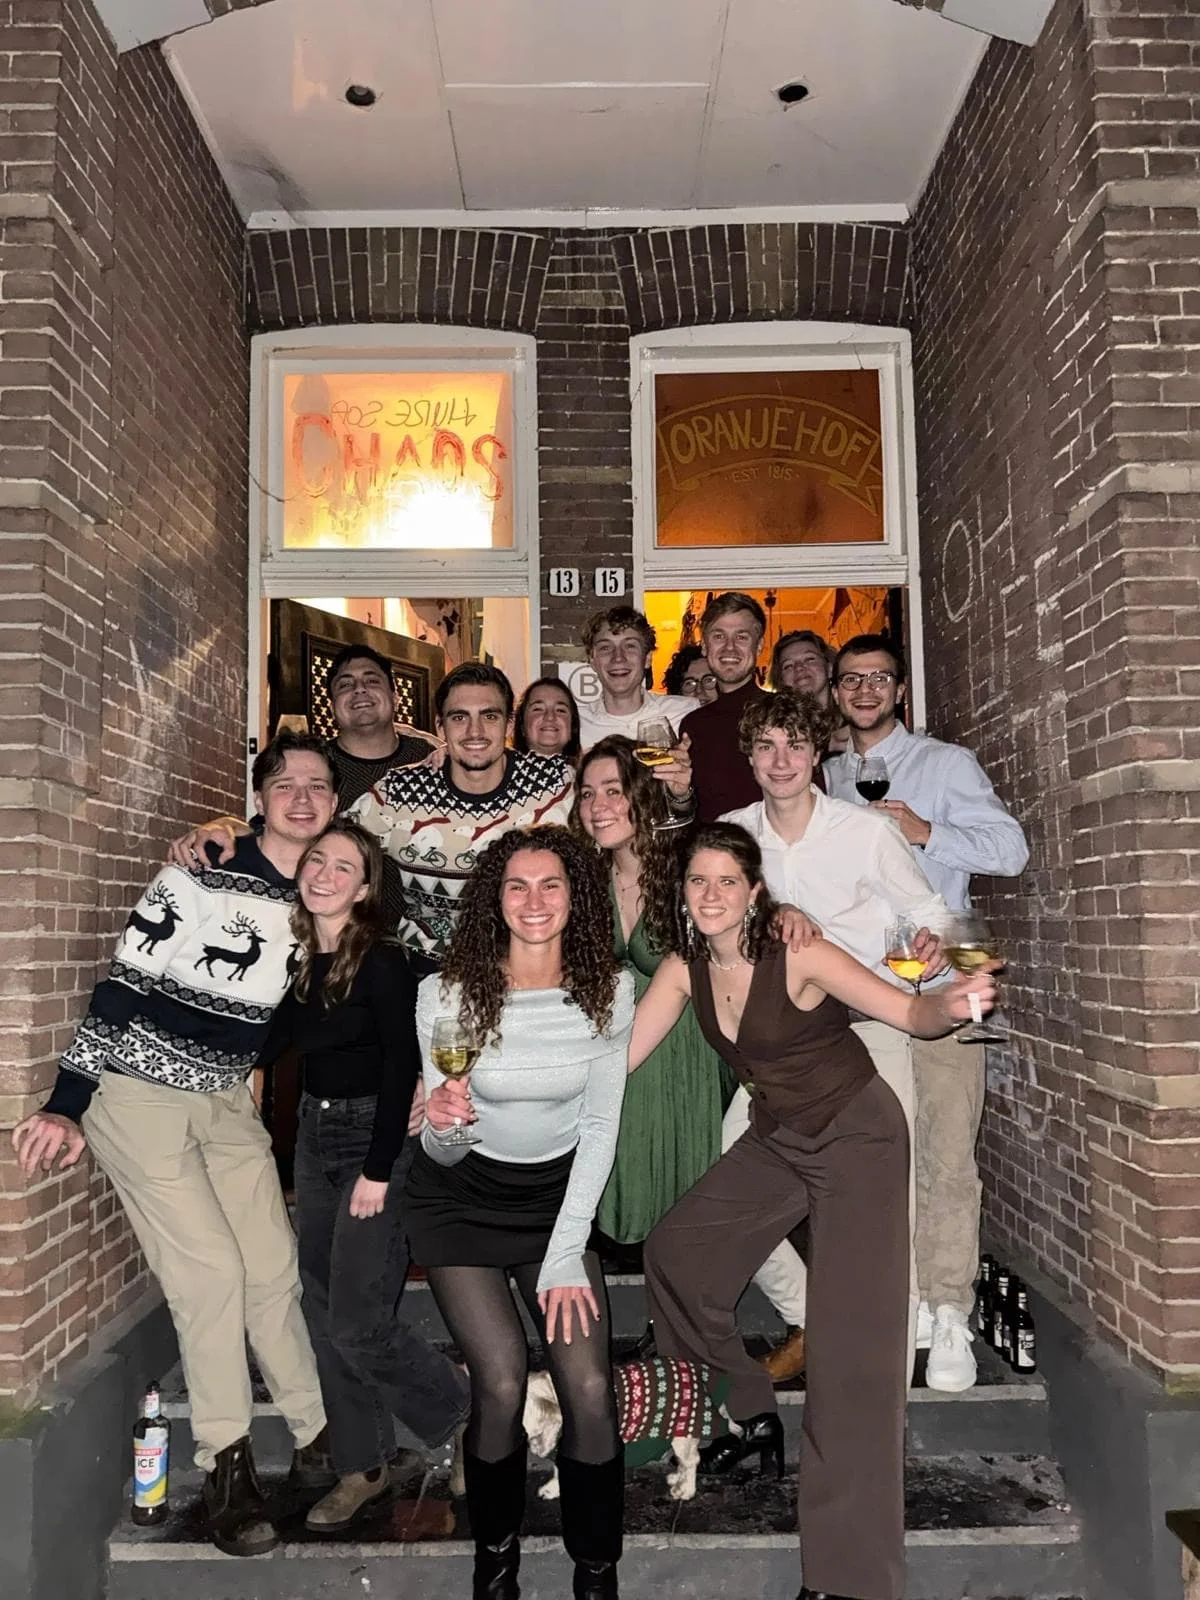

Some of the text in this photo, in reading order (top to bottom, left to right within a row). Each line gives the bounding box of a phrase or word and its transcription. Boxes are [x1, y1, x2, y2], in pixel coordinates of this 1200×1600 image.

[670, 407, 872, 466] ORANJEHOF
[555, 570, 573, 594] 13
[601, 570, 619, 594] 15
[580, 673, 600, 697] B
[137, 1457, 155, 1468] ICE
